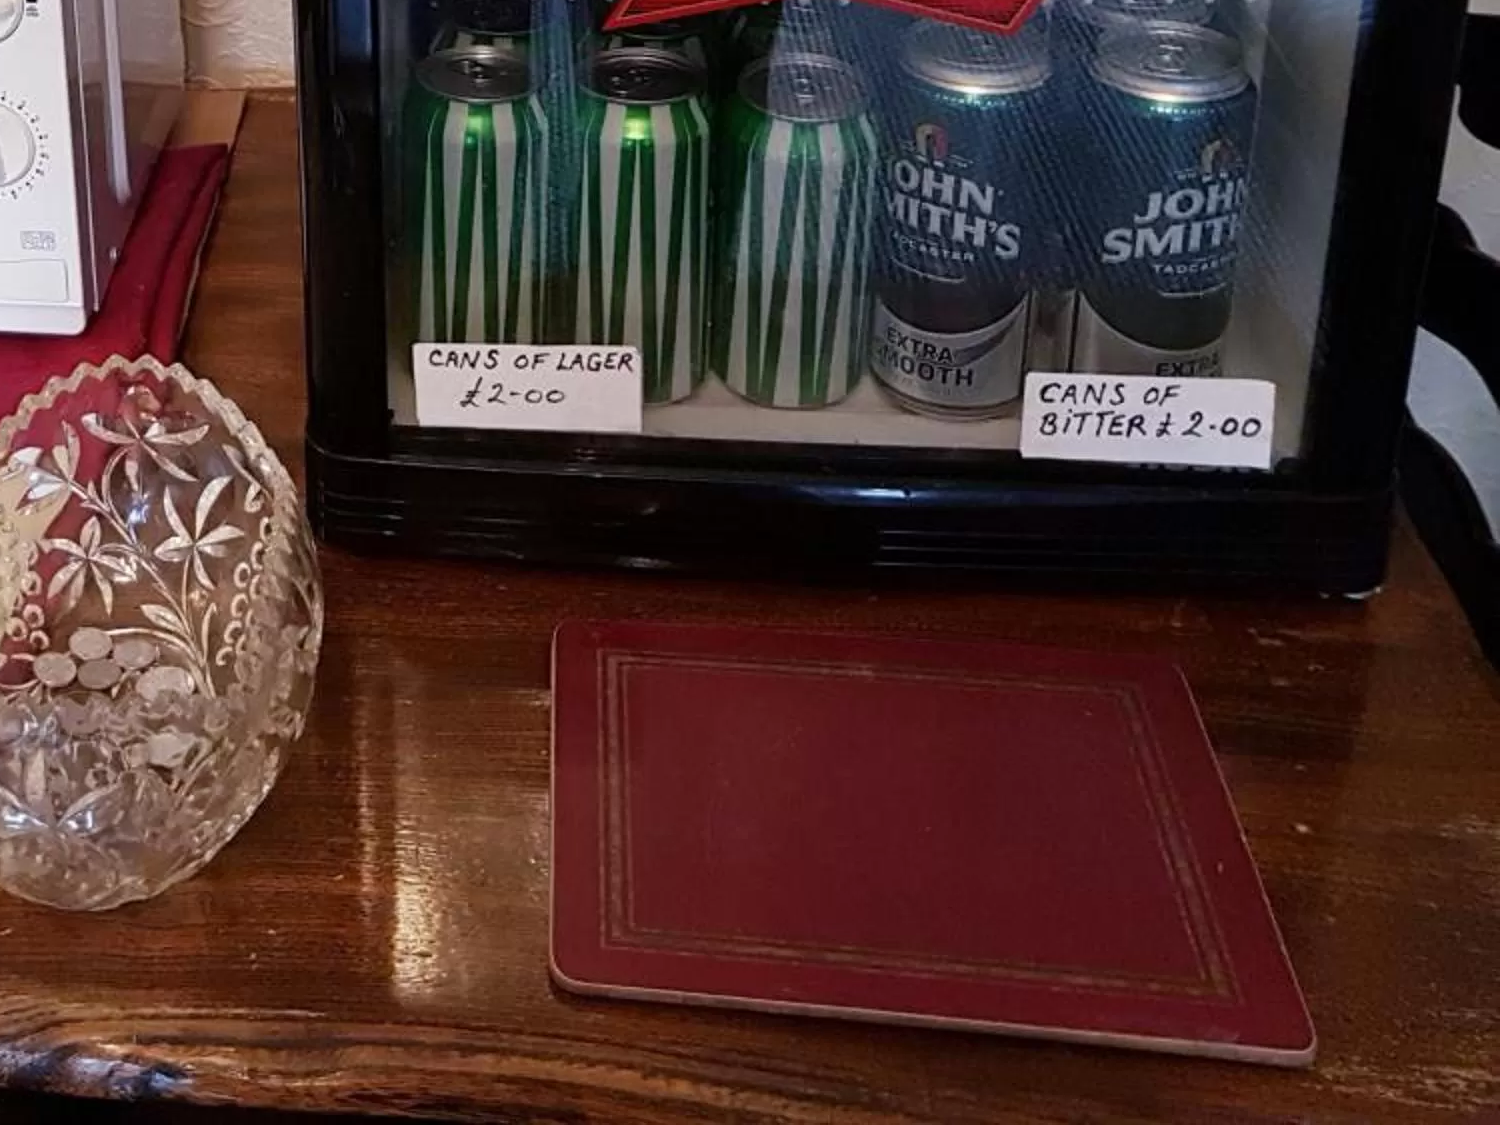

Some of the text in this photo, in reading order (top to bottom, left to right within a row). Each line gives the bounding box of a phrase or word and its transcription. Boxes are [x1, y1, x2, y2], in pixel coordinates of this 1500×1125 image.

[886, 326, 954, 364] EXTRA
[429, 349, 634, 373] CANS OF LAGER
[1039, 382, 1183, 407] CANS OF
